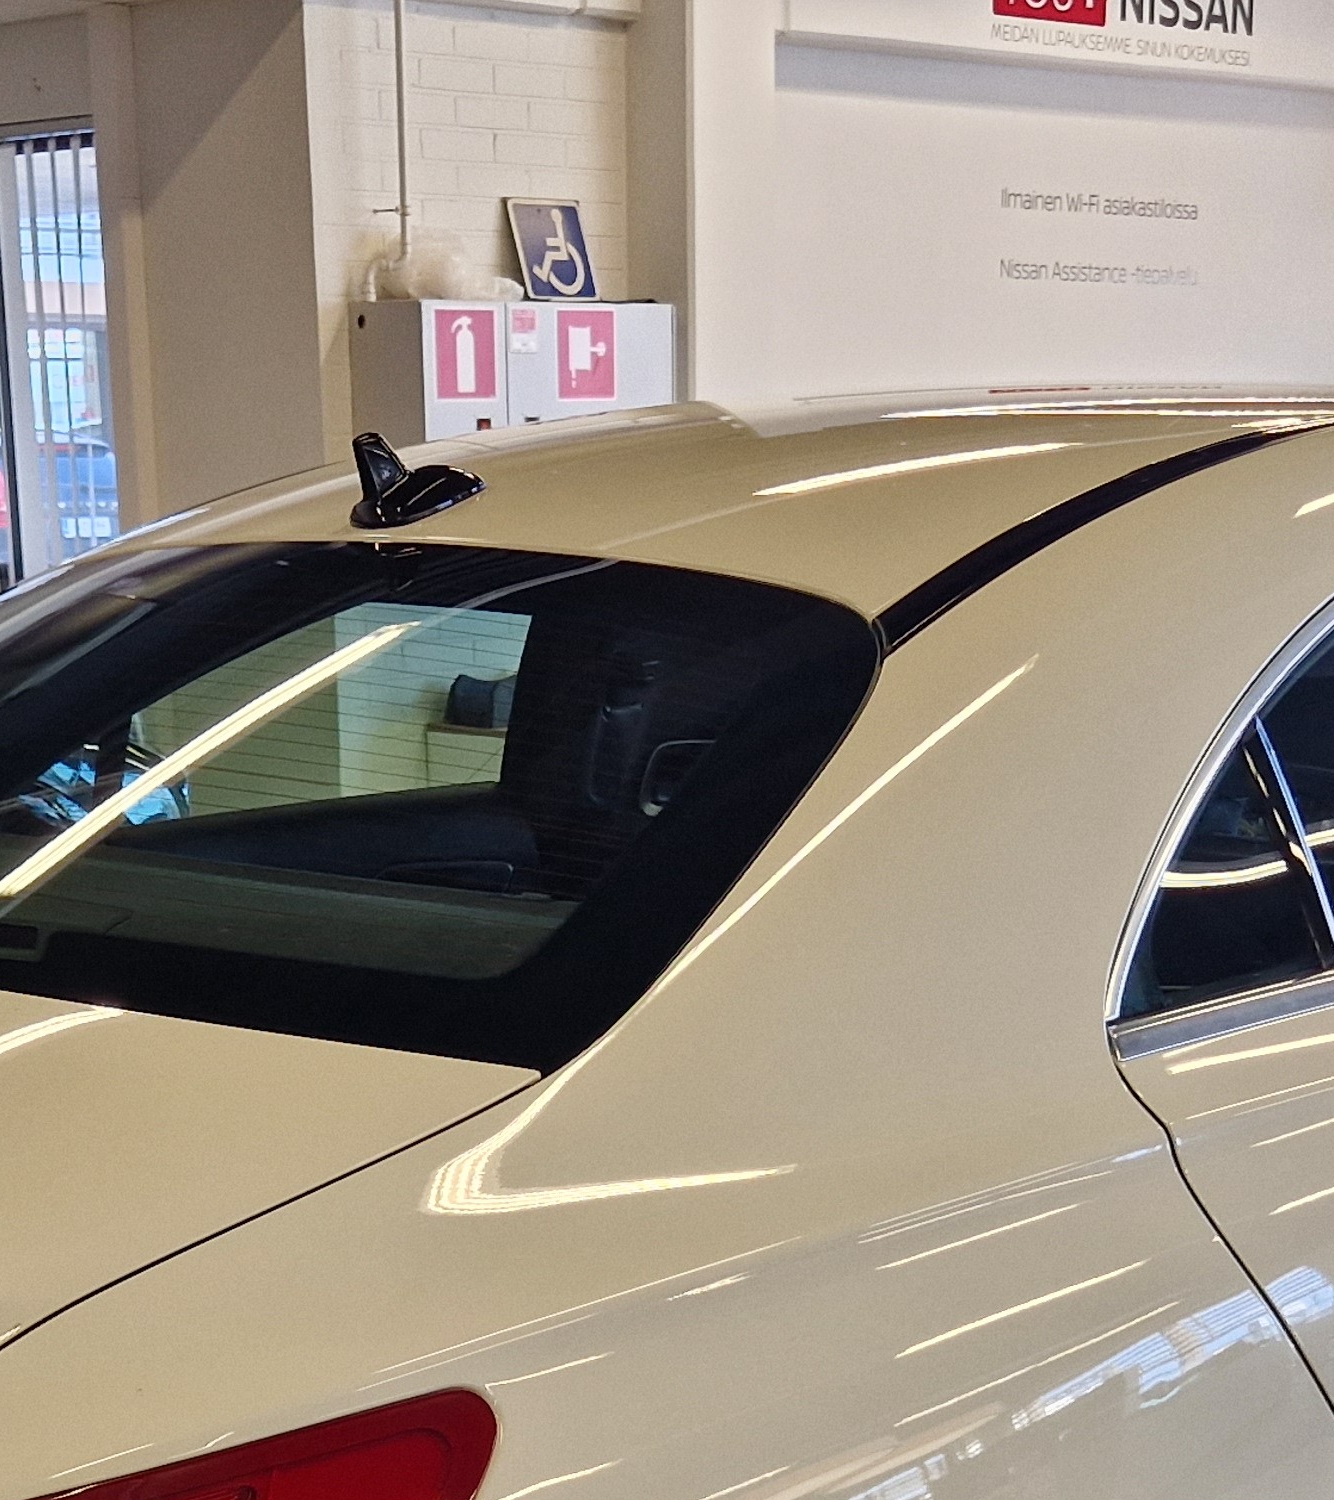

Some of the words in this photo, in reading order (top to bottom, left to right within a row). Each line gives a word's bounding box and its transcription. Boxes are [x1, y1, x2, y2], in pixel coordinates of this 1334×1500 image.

[1000, 187, 1062, 211] Ilmainen
[1066, 193, 1100, 213] Wi-Fi
[1103, 196, 1198, 220] asiakastiloissa
[999, 258, 1047, 280] Nissan
[1051, 261, 1127, 283] Assistance
